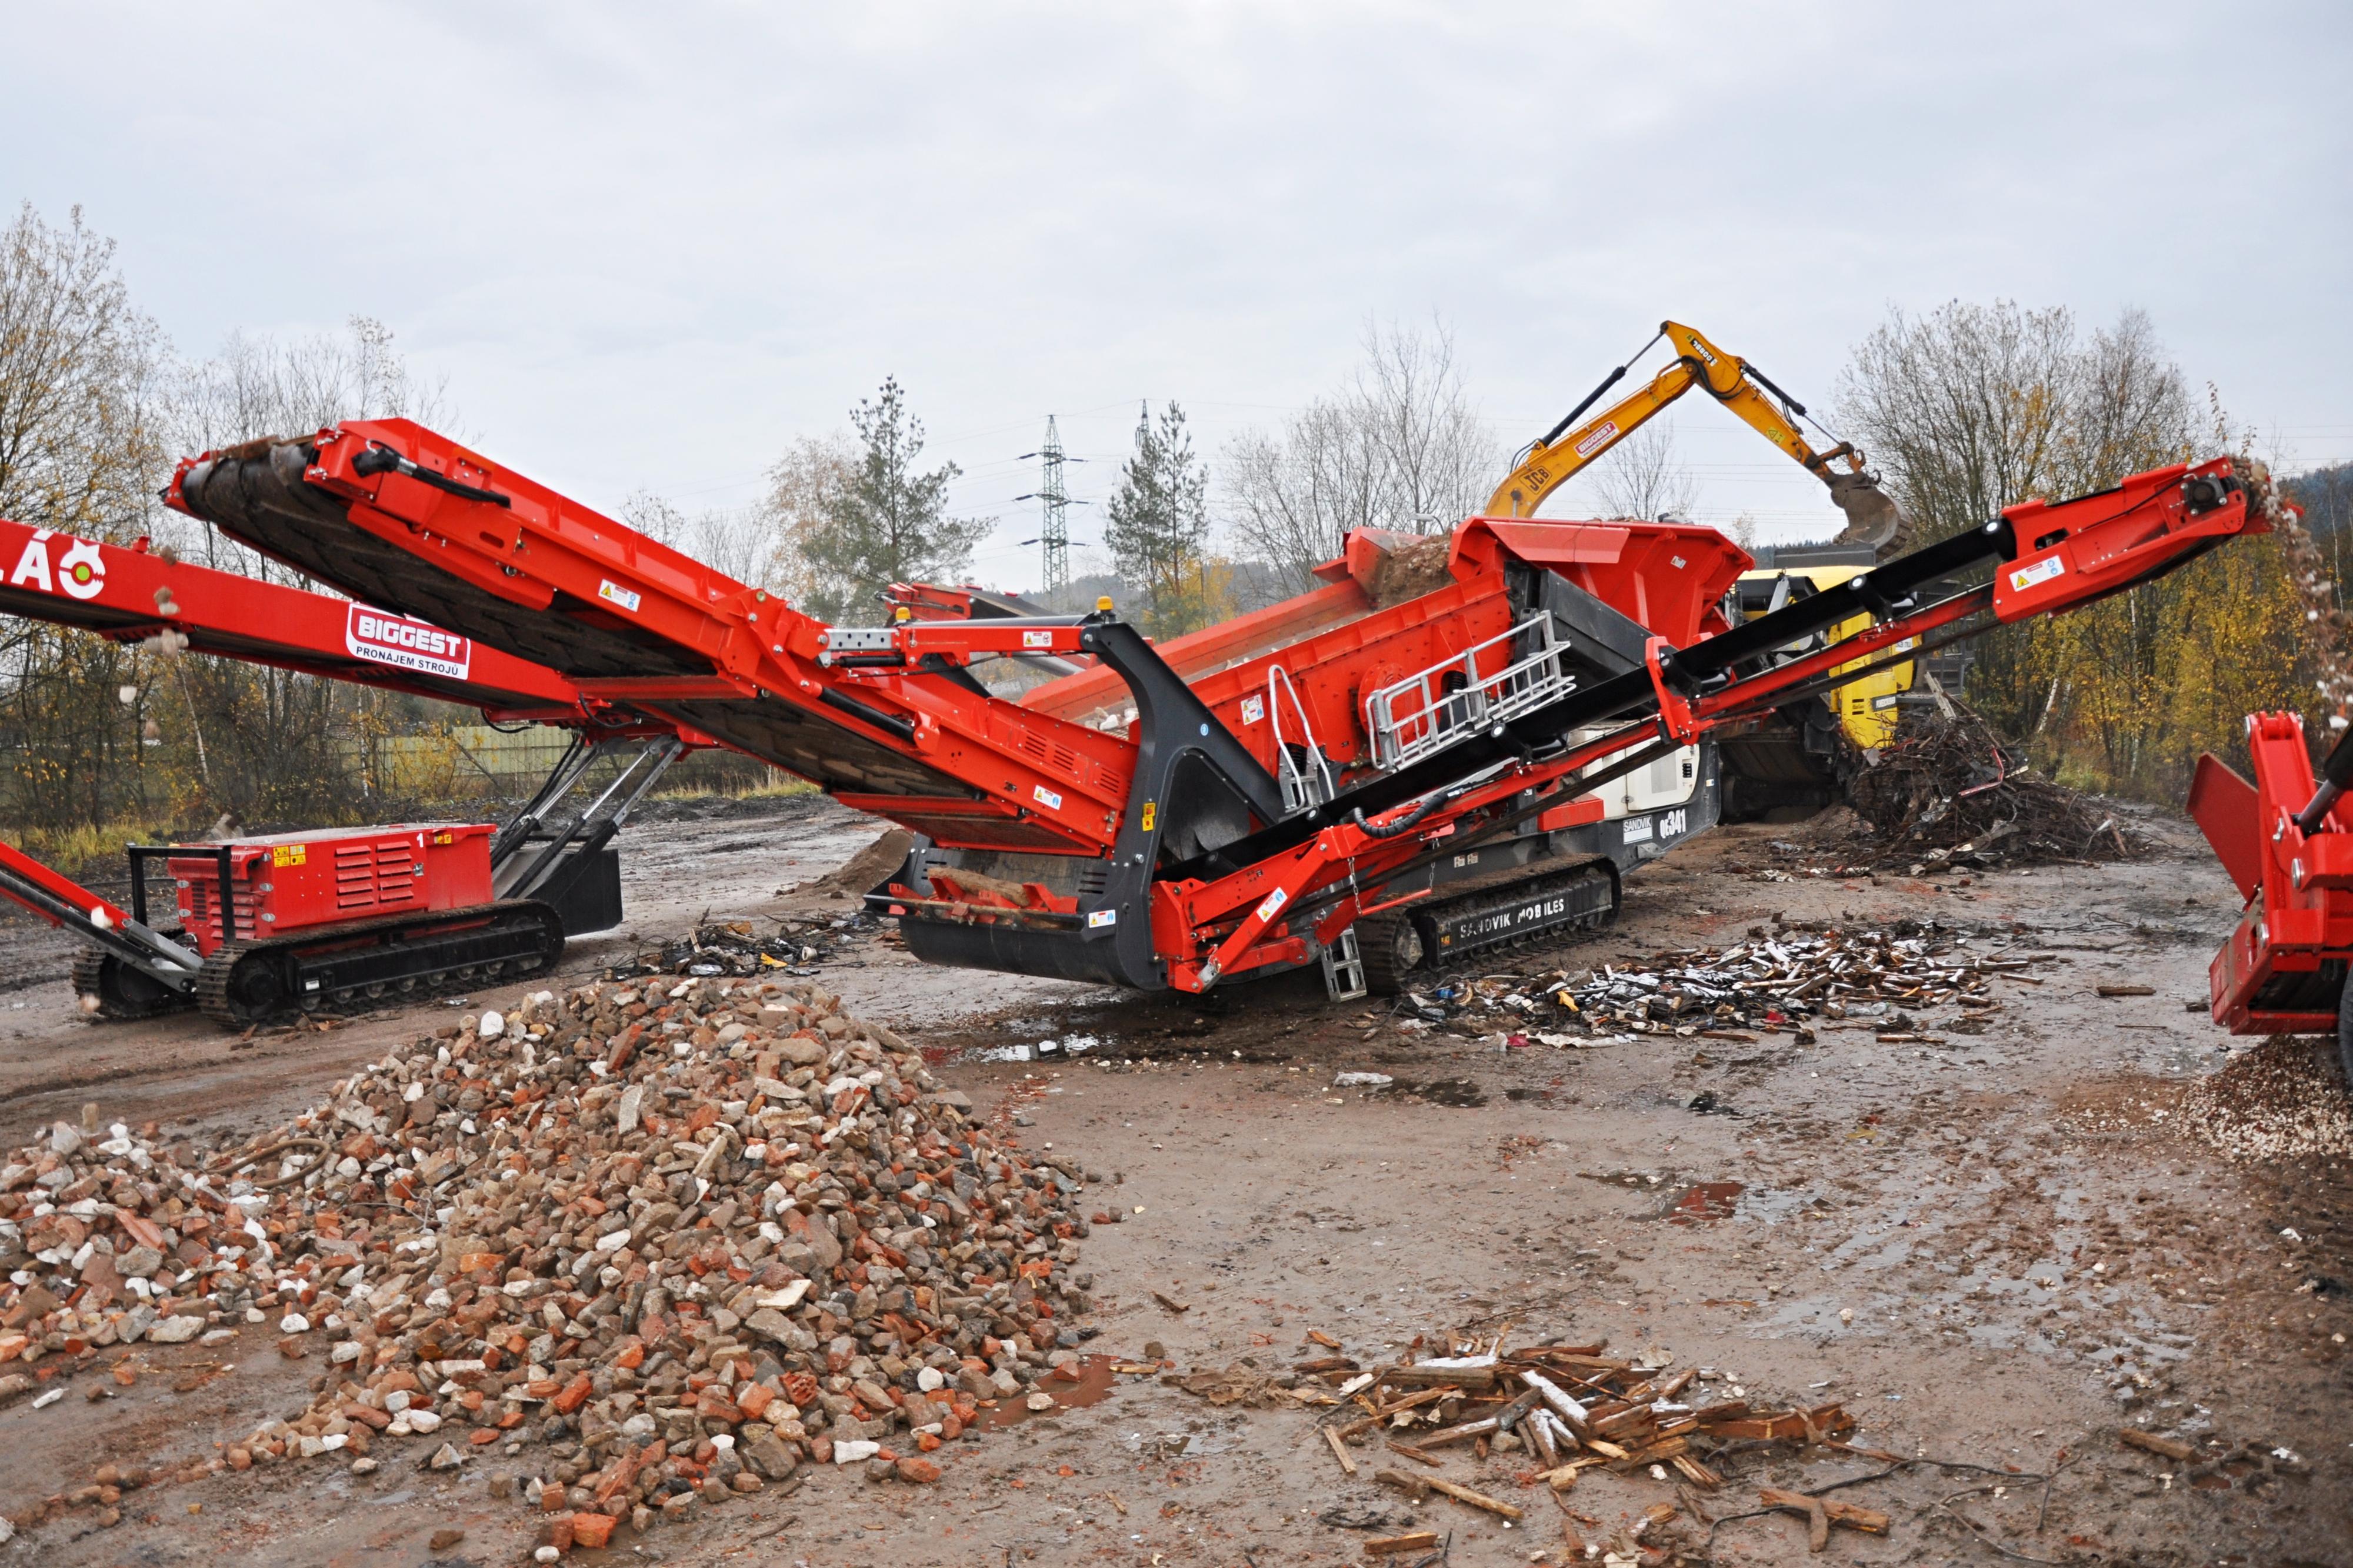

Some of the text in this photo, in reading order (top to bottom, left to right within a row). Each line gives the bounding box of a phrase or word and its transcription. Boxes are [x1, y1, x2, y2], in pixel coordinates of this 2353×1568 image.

[1578, 423, 1612, 452] BIGGEST
[1524, 468, 1549, 492] JCB
[358, 615, 461, 657] BIGGEST
[356, 646, 458, 675] PRONÁJEM STROJŮ
[1624, 816, 1652, 832] SANDVIK
[1659, 809, 1686, 839] QE341
[416, 832, 424, 848] 1
[1460, 899, 1565, 938] SANDVIK MOBILES
